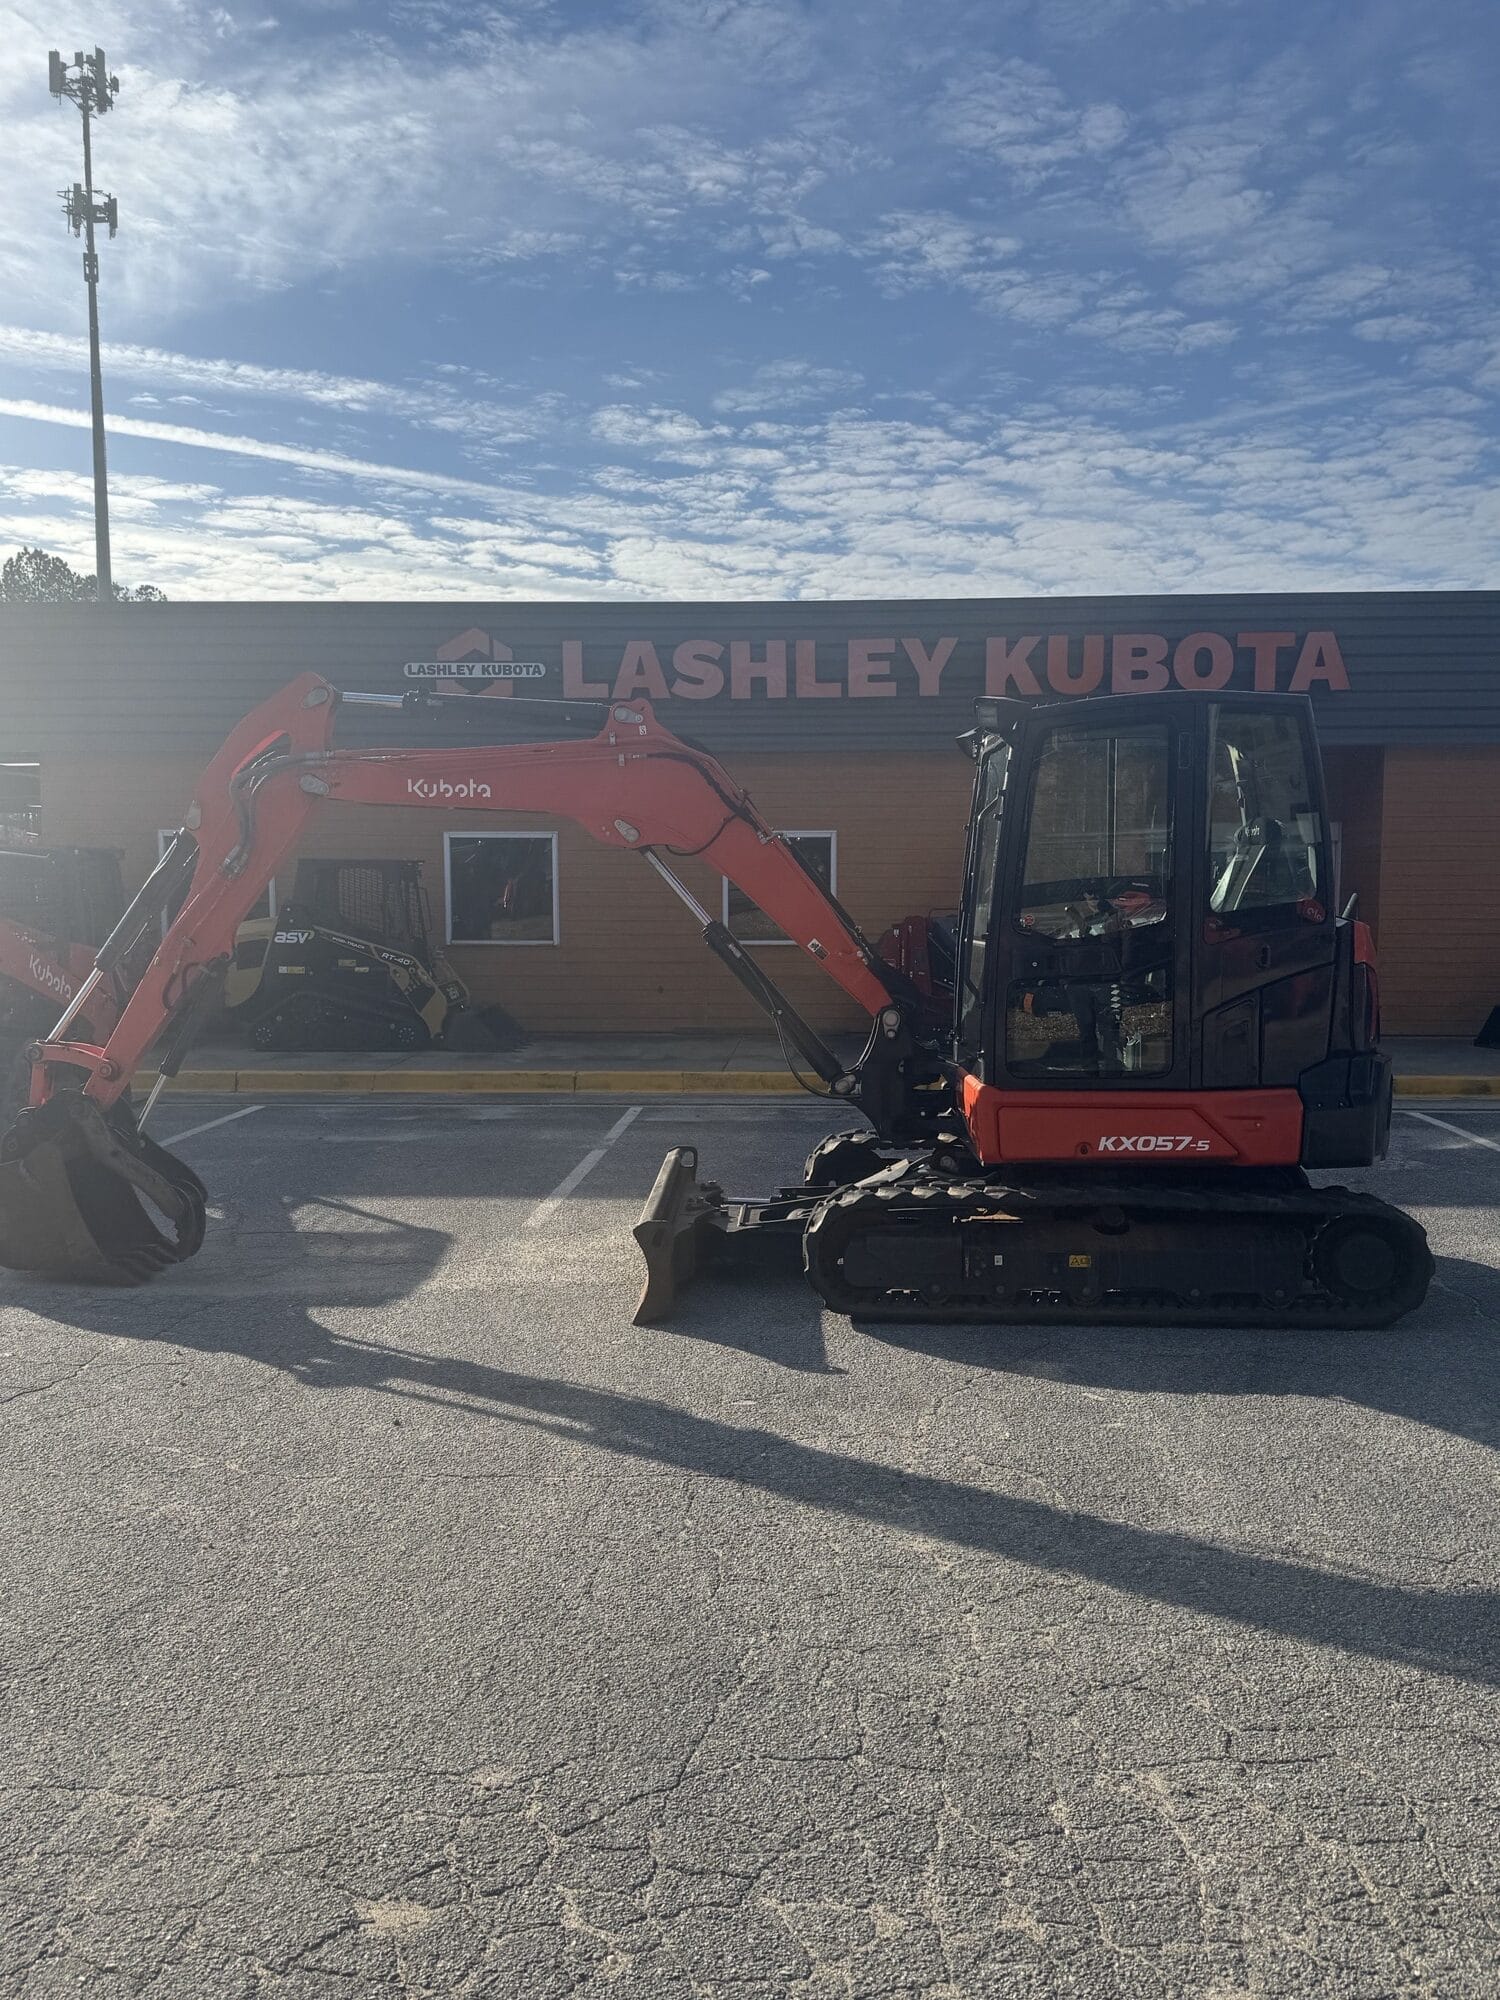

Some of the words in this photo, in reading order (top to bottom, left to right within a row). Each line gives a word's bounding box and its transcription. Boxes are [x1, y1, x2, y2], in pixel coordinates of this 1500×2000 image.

[407, 664, 476, 676] LASHLEY
[481, 664, 543, 676] KUBOTA
[561, 636, 960, 700] LASHLEY
[985, 631, 1351, 696] KUBOTA
[407, 778, 492, 798] Kubota
[29, 953, 72, 1001] Kubota
[1098, 1135, 1210, 1152] KX057-5
